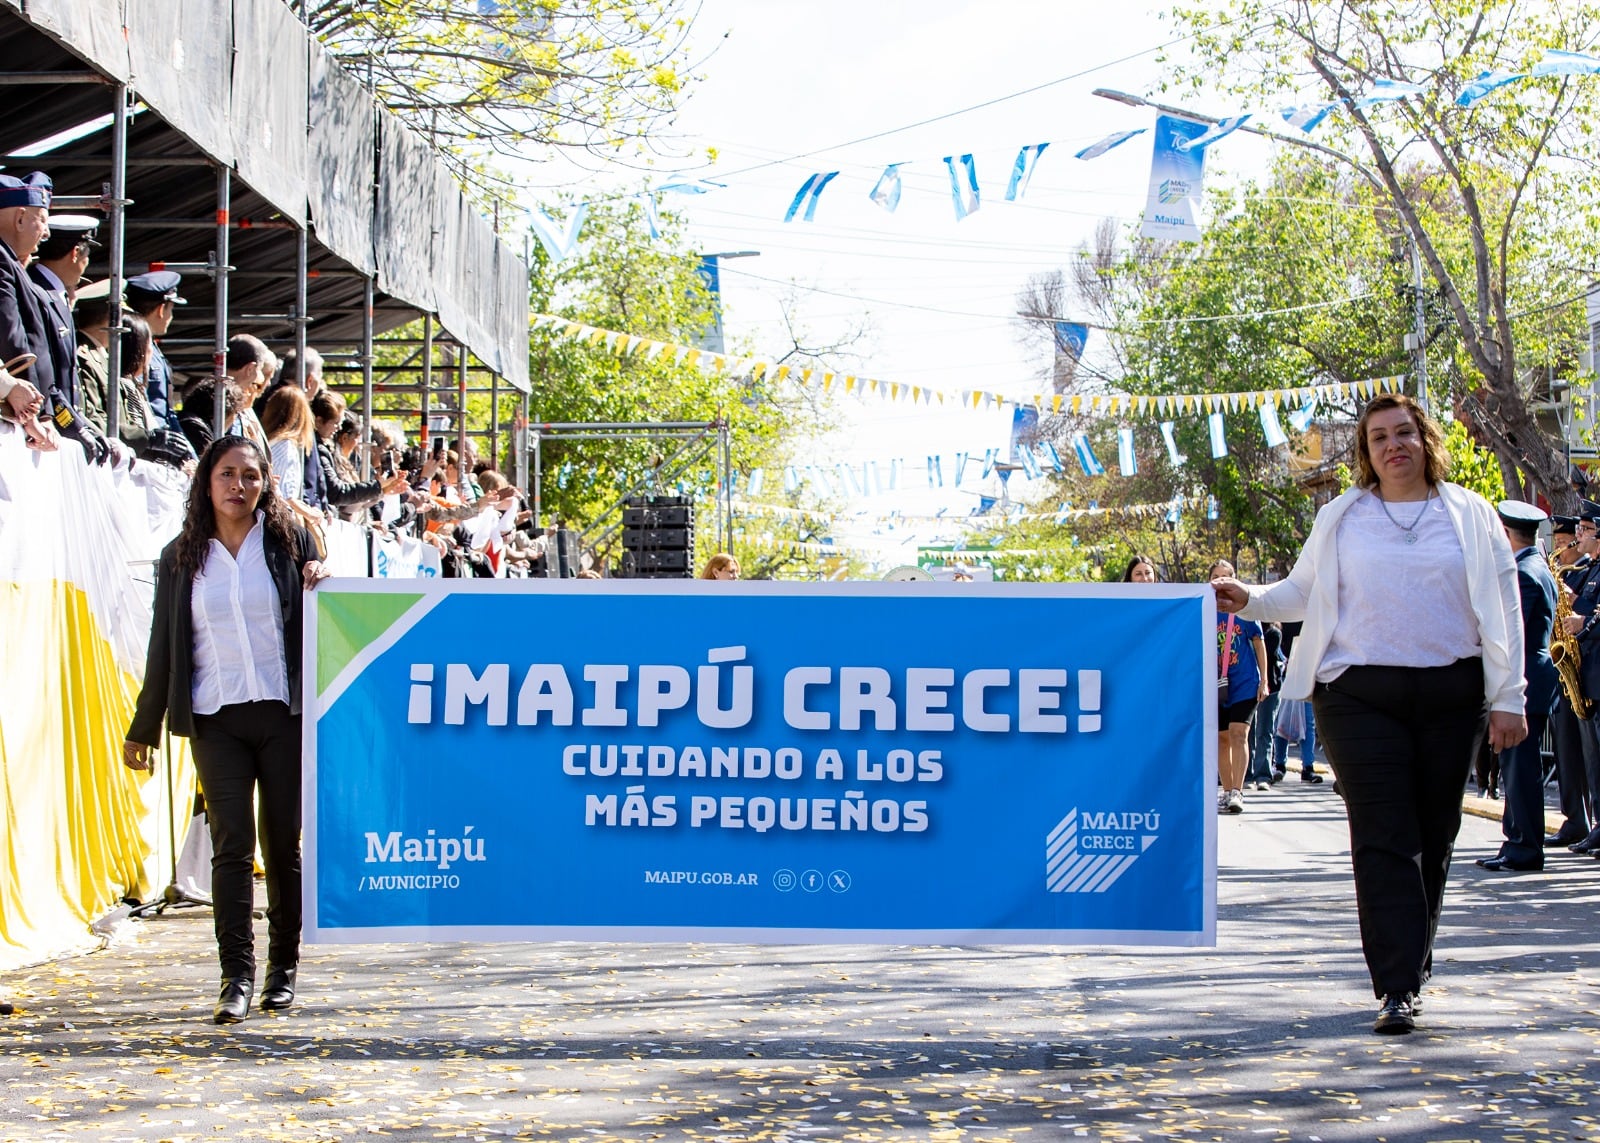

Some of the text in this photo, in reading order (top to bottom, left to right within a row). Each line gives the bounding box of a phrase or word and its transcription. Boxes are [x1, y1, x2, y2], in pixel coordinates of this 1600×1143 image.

[407, 645, 1102, 733] ¡MAIPÚ CRECE!
[562, 744, 943, 782] CUIDANDO A LOS
[585, 785, 929, 834] MÁS PEQUEÑOS
[1081, 808, 1160, 831] MAIPÚ
[364, 825, 486, 870] Maipú
[1081, 835, 1135, 850] CRECE
[368, 874, 460, 890] MUNICIPIO
[644, 870, 759, 886] MAIPU.GOB.AR
